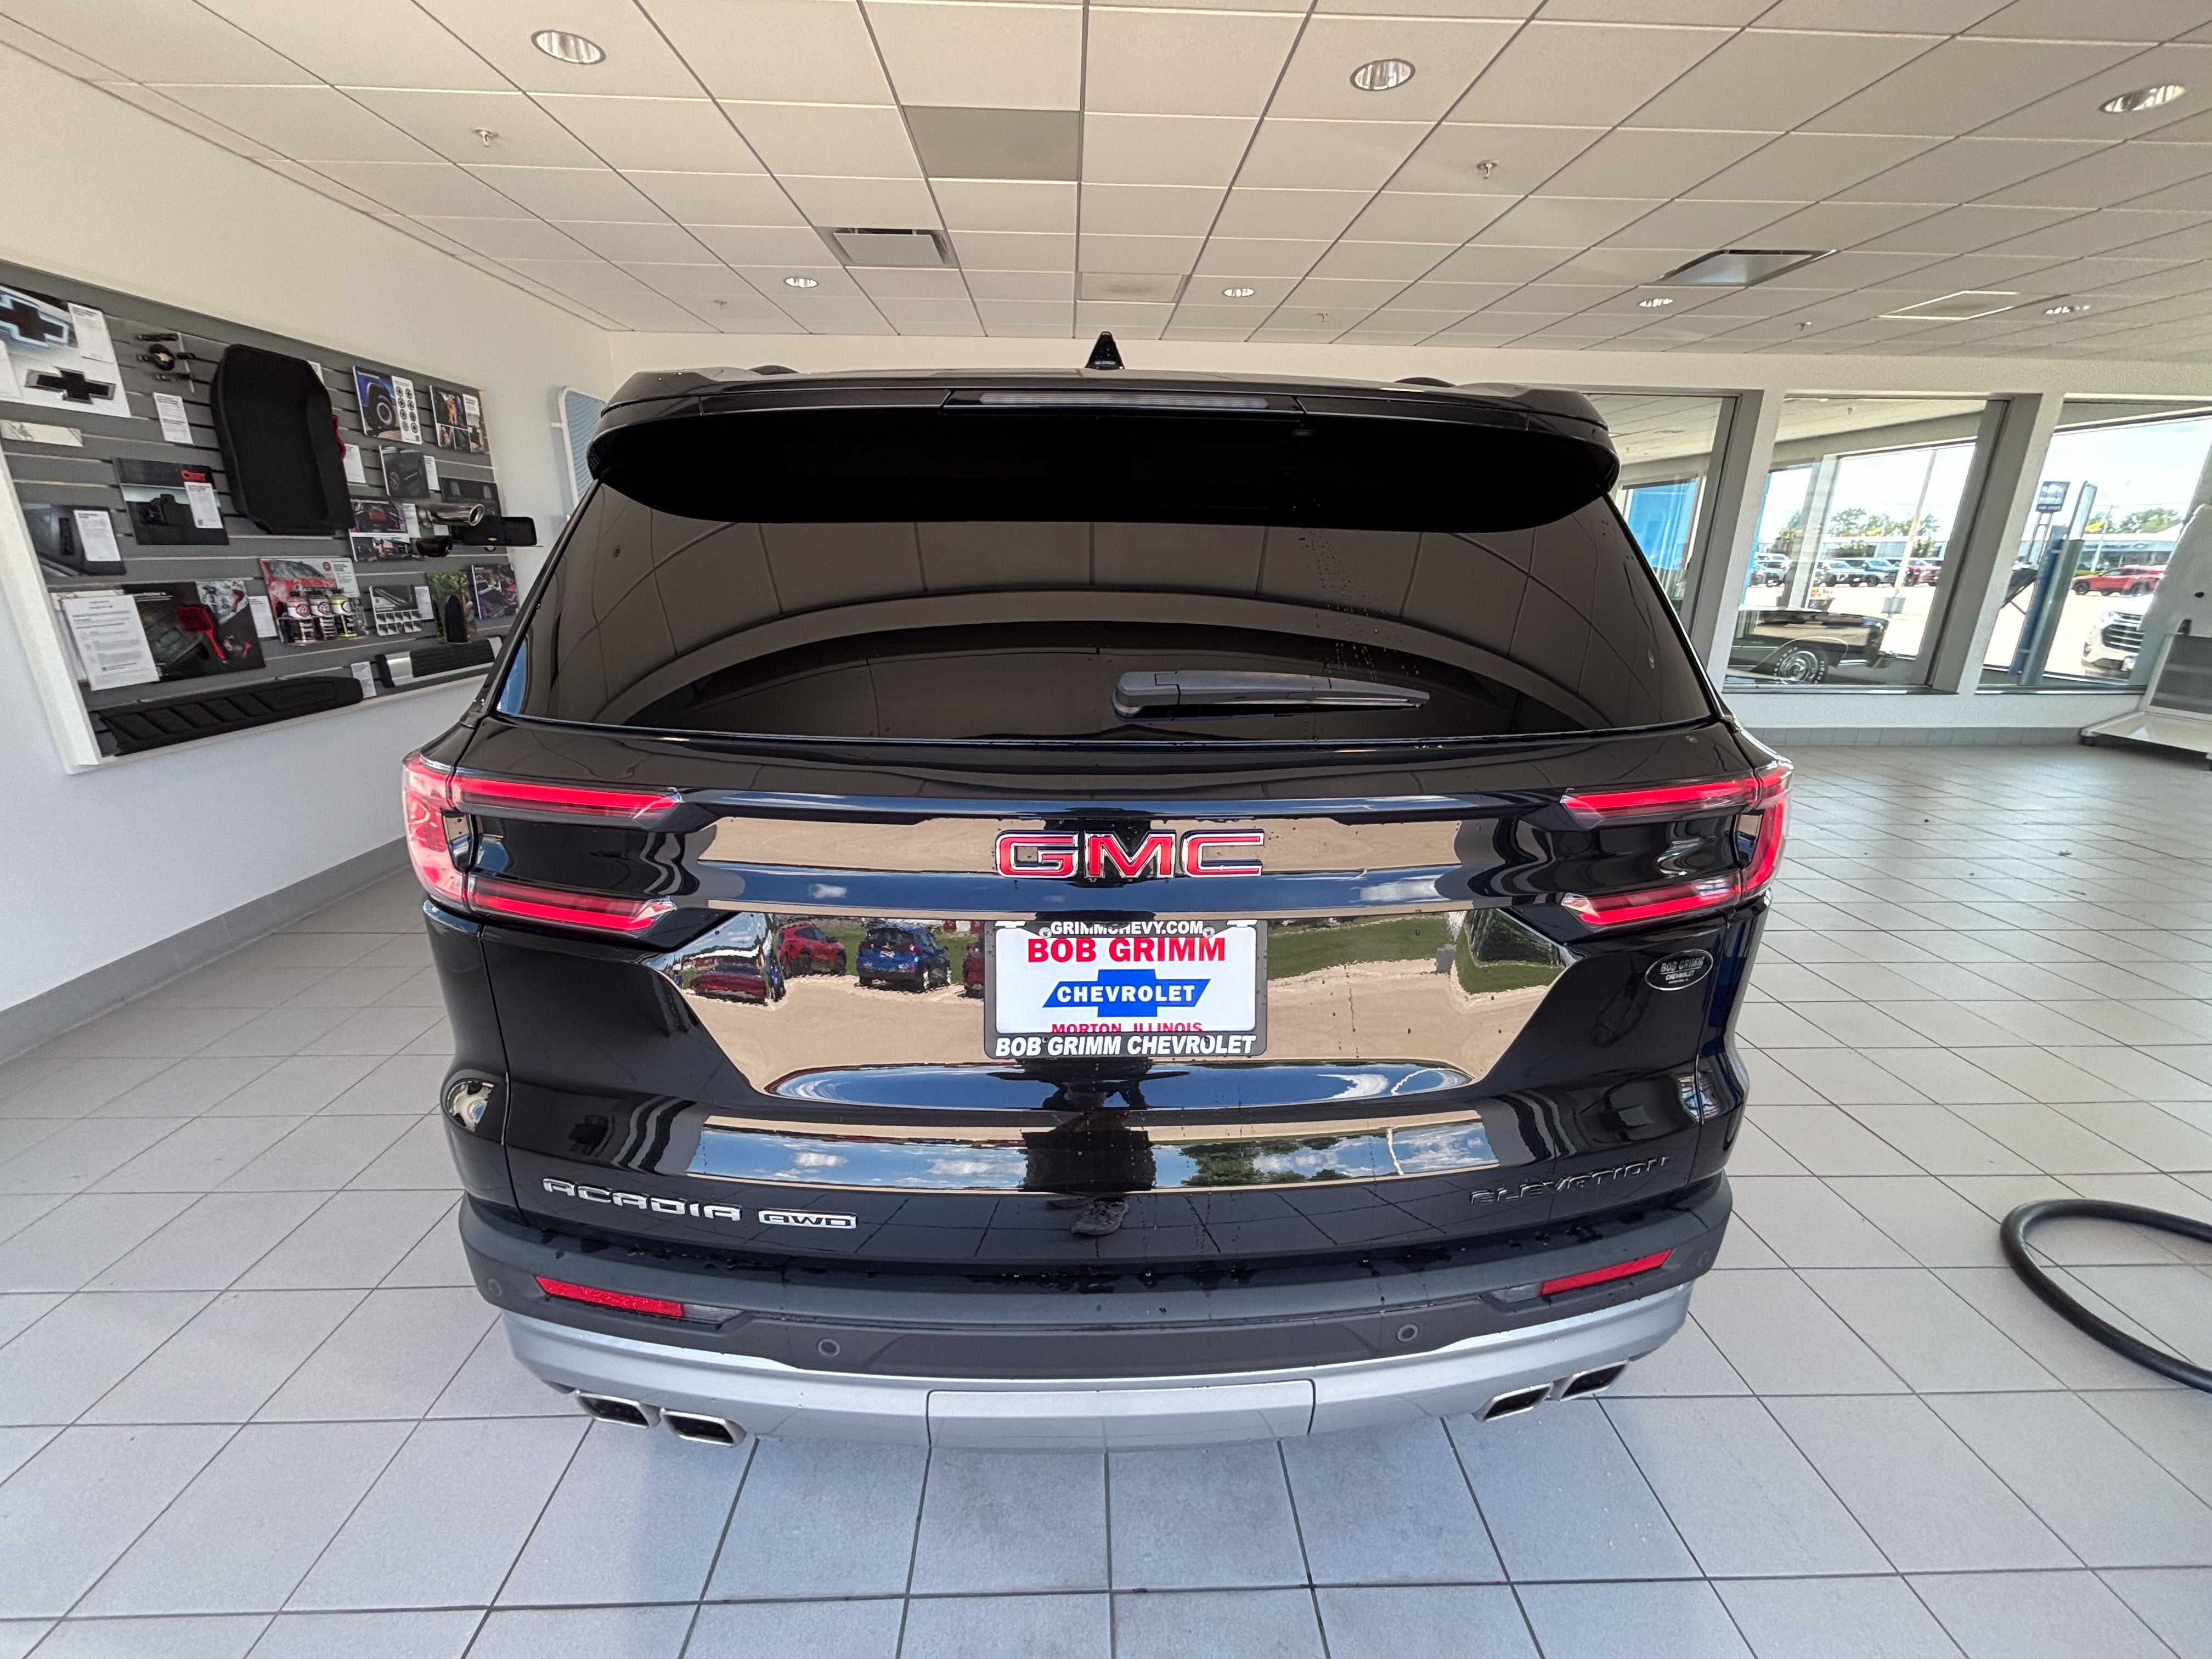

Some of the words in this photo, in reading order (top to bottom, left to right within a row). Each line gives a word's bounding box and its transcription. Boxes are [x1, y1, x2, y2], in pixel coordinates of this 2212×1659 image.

[995, 830, 1264, 878] GMC
[1028, 938, 1097, 962] BOB
[1109, 937, 1226, 962] GRIMM
[1660, 962, 1678, 973] BOB
[1057, 985, 1195, 1002] CHEVROLET
[995, 1037, 1041, 1056] BOB
[1046, 1035, 1121, 1056] GRIMM
[1126, 1034, 1257, 1056] CHEVROLET
[1470, 1156, 1669, 1205] ELEVATION
[542, 1178, 742, 1221] ACADIA
[763, 1212, 854, 1228] AWD
